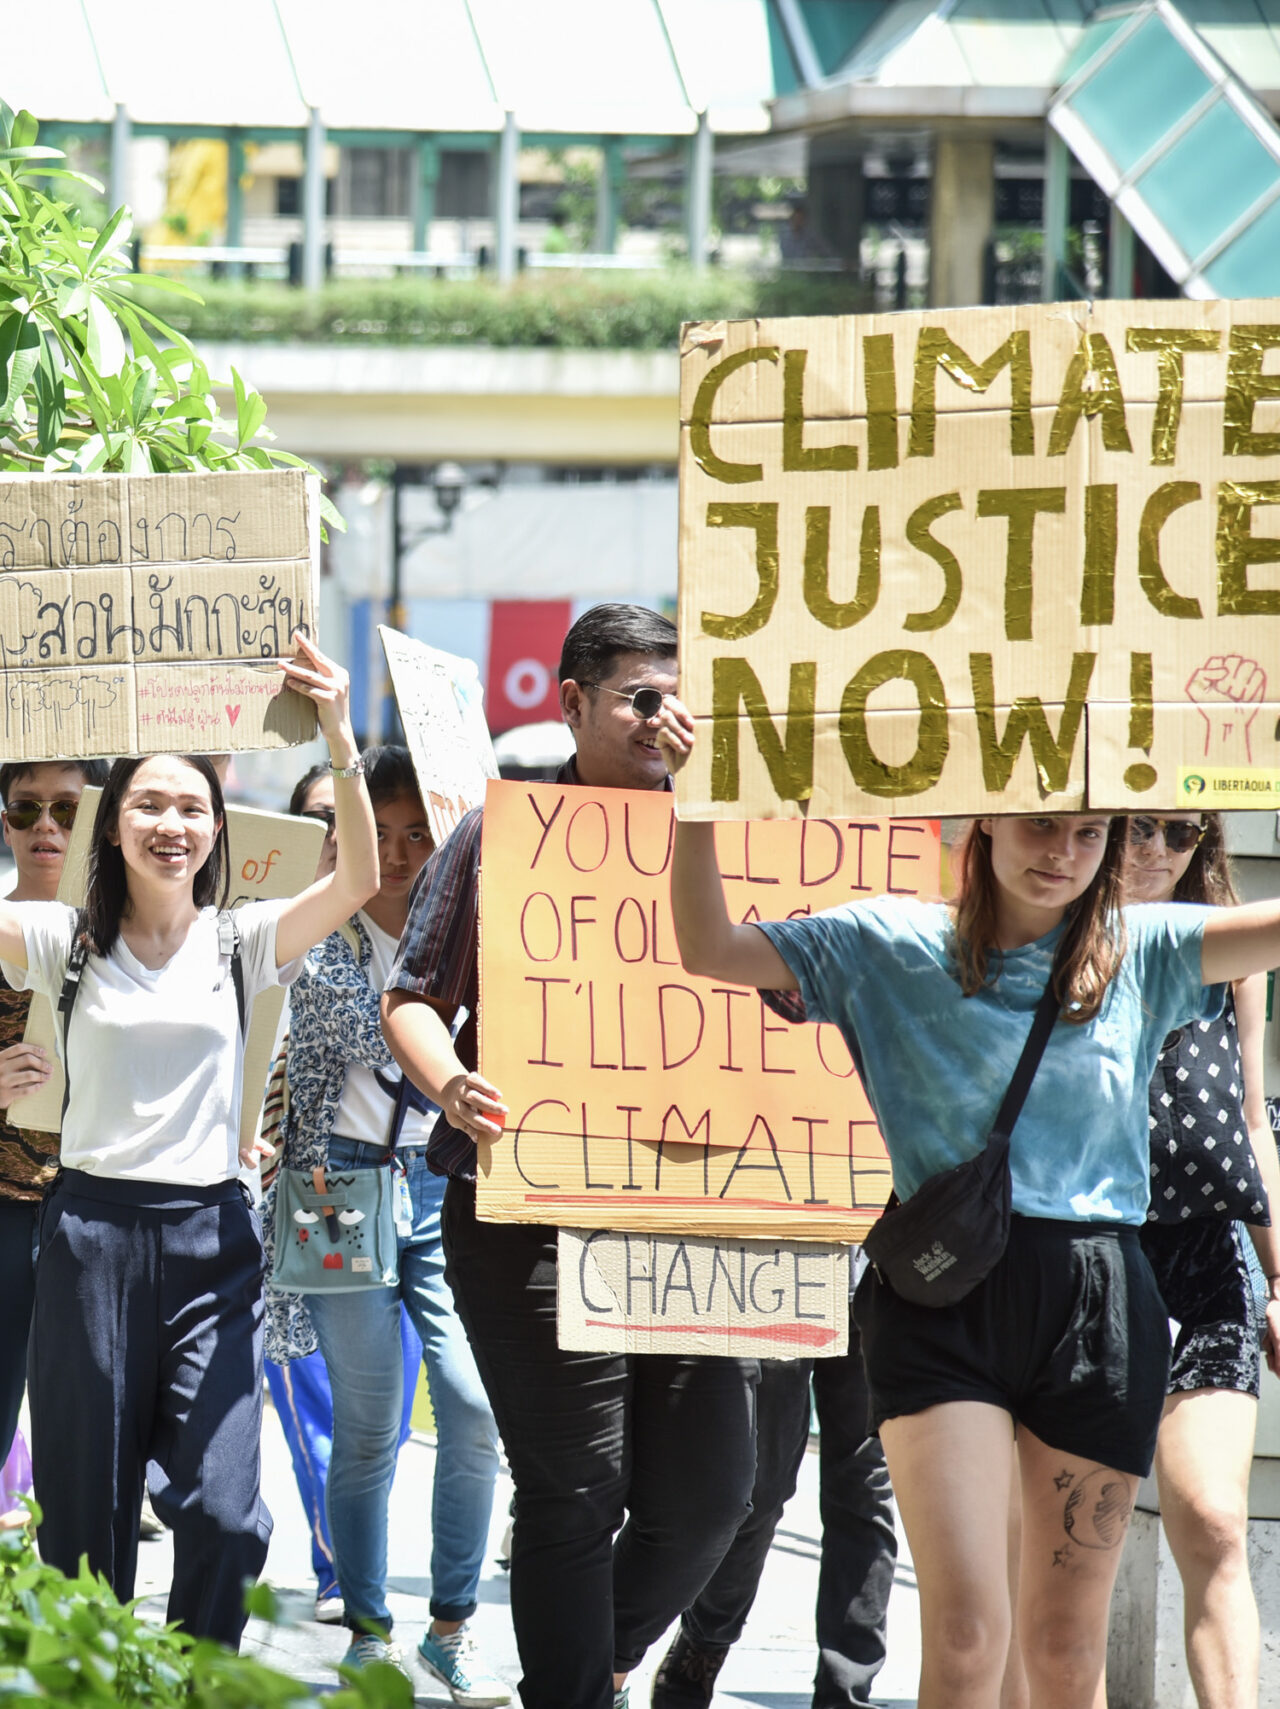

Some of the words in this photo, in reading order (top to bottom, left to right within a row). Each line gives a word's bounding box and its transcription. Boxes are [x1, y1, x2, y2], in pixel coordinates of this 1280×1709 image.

[690, 324, 1280, 484] CLIMATE
[701, 480, 1280, 641] JUSTICE
[37, 573, 310, 659] สวนมักกะสัน
[710, 649, 1158, 803] NOW!
[242, 849, 282, 884] of
[521, 892, 597, 963] OF
[524, 976, 647, 1072] I'LL
[658, 984, 796, 1075] DIE
[514, 1099, 891, 1208] CLIMATE
[579, 1229, 830, 1320] CHANGE
